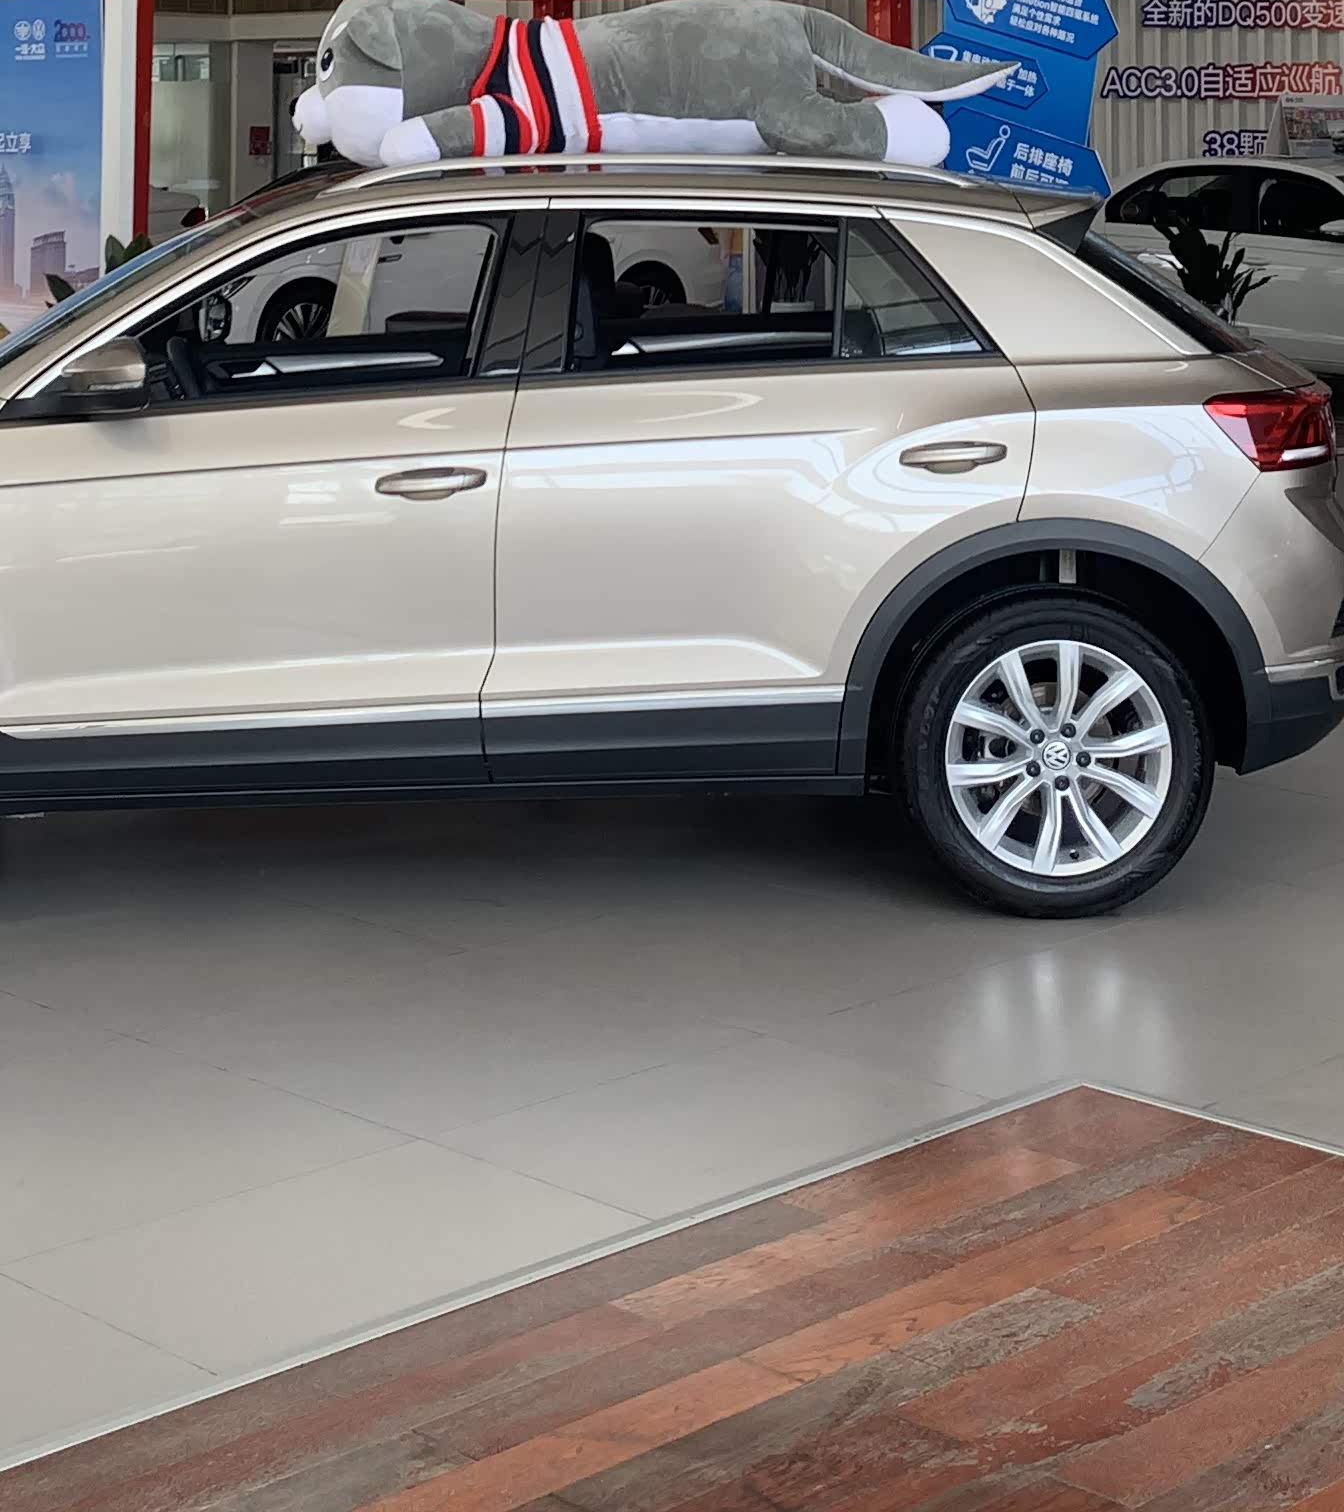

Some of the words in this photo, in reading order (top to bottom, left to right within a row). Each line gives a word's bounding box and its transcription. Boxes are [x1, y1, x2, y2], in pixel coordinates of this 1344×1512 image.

[1102, 62, 1342, 98] ACC3.0自适应巡航
[1013, 143, 1073, 178] 后排座椅
